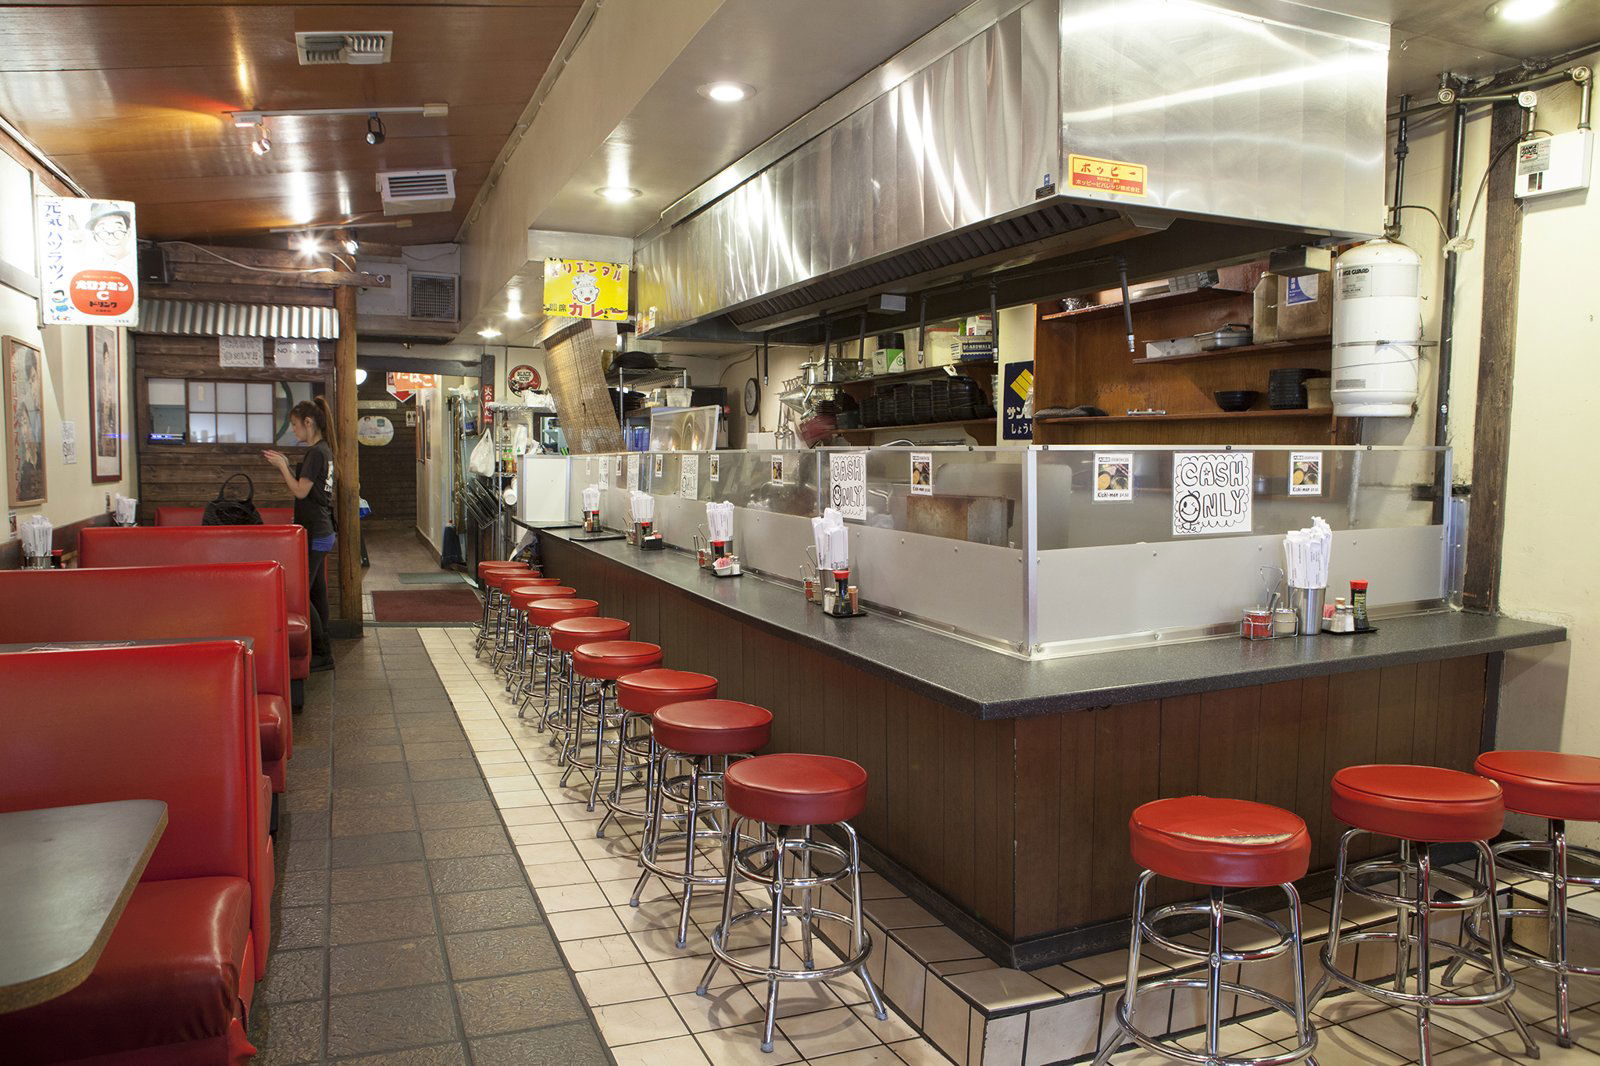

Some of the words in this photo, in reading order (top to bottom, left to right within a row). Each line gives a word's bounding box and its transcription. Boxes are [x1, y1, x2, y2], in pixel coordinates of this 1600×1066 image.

[1081, 163, 1136, 177] ホッピー
[96, 290, 110, 301] C
[833, 459, 862, 482] CASH
[1181, 460, 1244, 487] CASH
[832, 484, 864, 507] ONLY
[1178, 489, 1246, 524] ONLY
